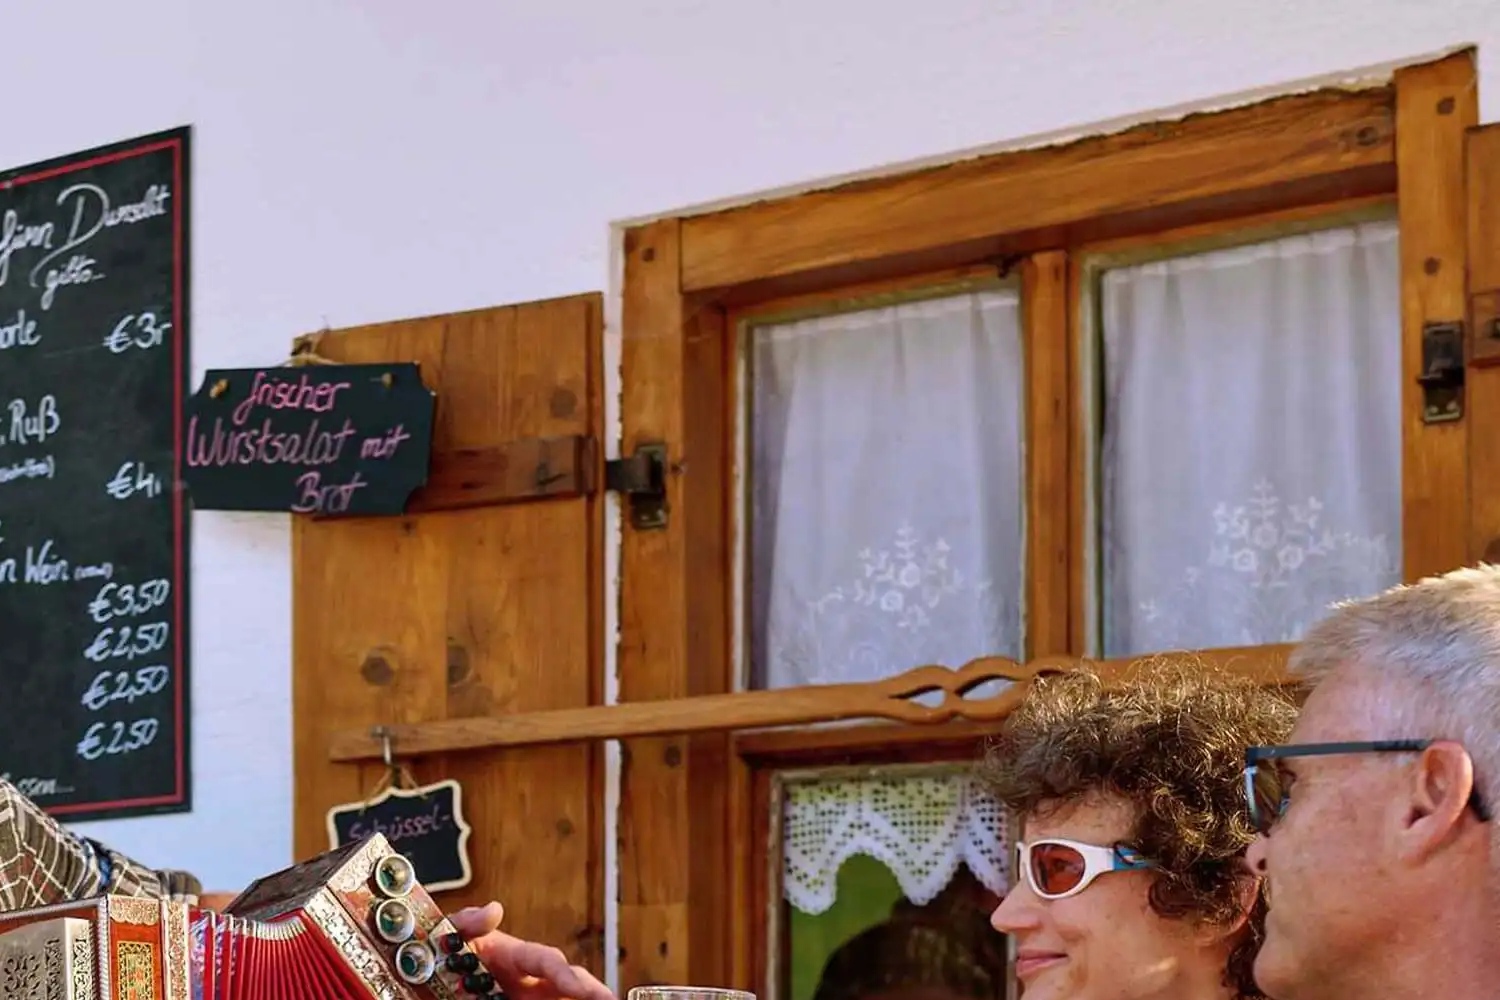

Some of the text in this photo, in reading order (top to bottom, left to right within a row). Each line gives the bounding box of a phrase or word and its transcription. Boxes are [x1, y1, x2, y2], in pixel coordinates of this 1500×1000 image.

[186, 416, 411, 468] Wurstsalat mit
[290, 471, 368, 514] Brot
[24, 540, 69, 584] Wein
[87, 579, 171, 623] €3,50
[83, 621, 170, 662] €2,50
[81, 665, 170, 710] €2,50
[76, 718, 160, 761] €2,50
